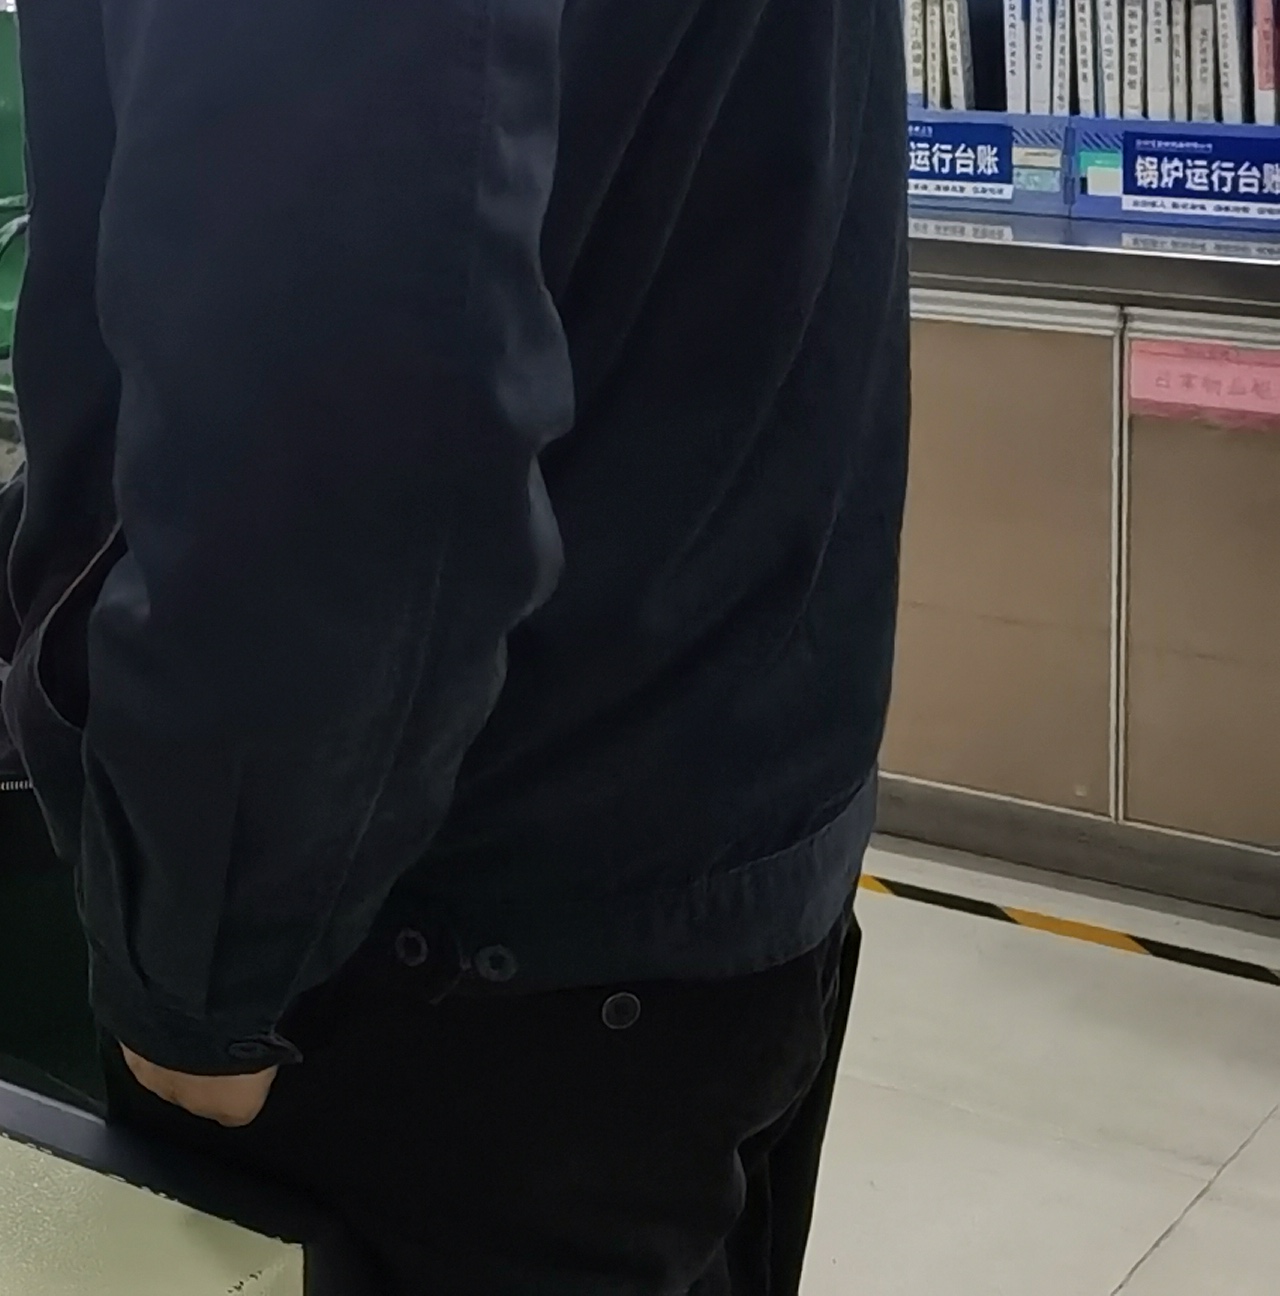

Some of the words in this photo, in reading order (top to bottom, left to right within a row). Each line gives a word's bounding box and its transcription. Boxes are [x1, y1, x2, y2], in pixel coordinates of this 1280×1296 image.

[909, 141, 1000, 176] 运行台账
[1135, 154, 1280, 196] 锅炉运行台账
